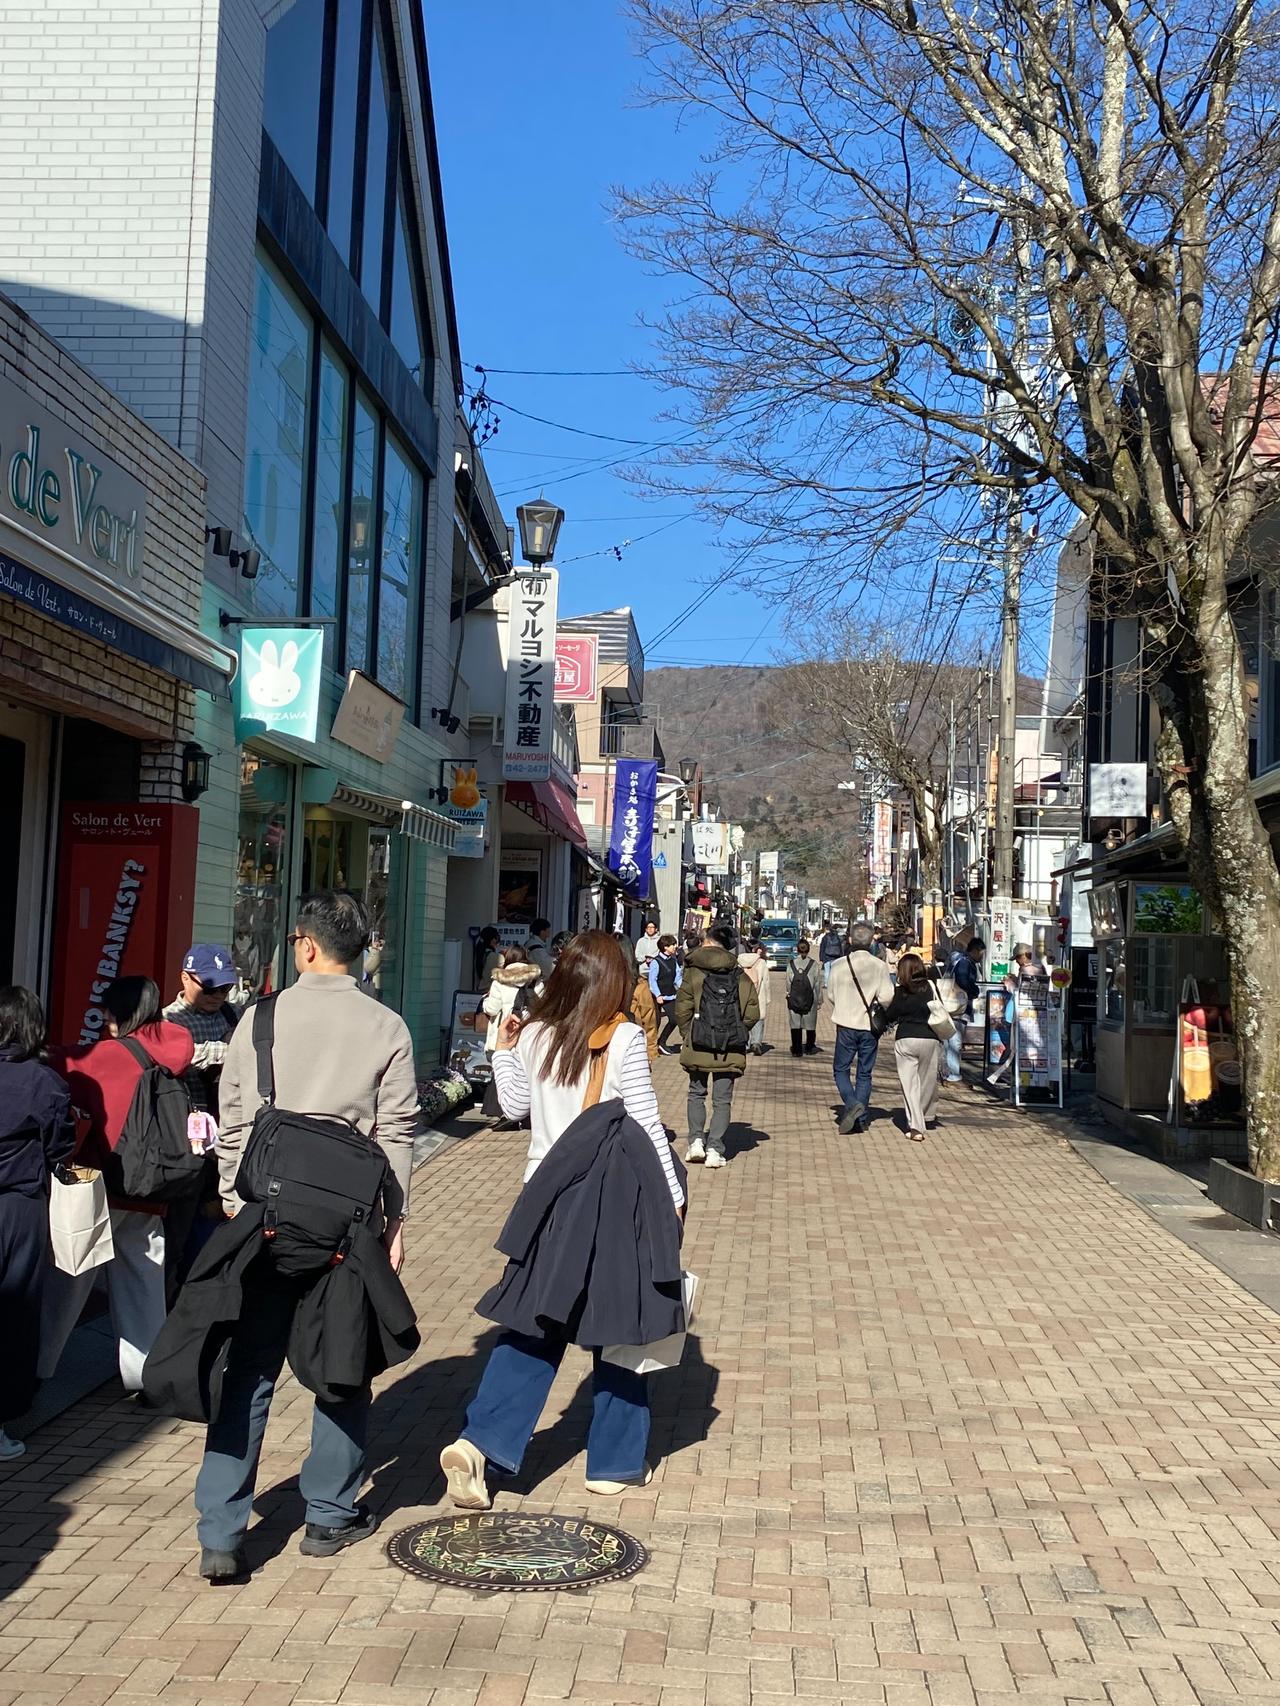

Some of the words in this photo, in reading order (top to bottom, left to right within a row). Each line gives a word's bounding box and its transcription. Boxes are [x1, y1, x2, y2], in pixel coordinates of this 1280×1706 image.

[8, 424, 61, 528] de
[64, 447, 139, 578] Vert
[0, 561, 23, 595] Salon
[24, 576, 34, 601] de
[505, 752, 549, 761] MARUYOSHI
[72, 812, 109, 826] Salon
[114, 813, 129, 826] de
[134, 813, 162, 827] Vert
[449, 808, 484, 818] RUIZAWA
[77, 1007, 105, 1047] HO
[96, 858, 146, 979] BANKSY?
[186, 955, 194, 969] 3
